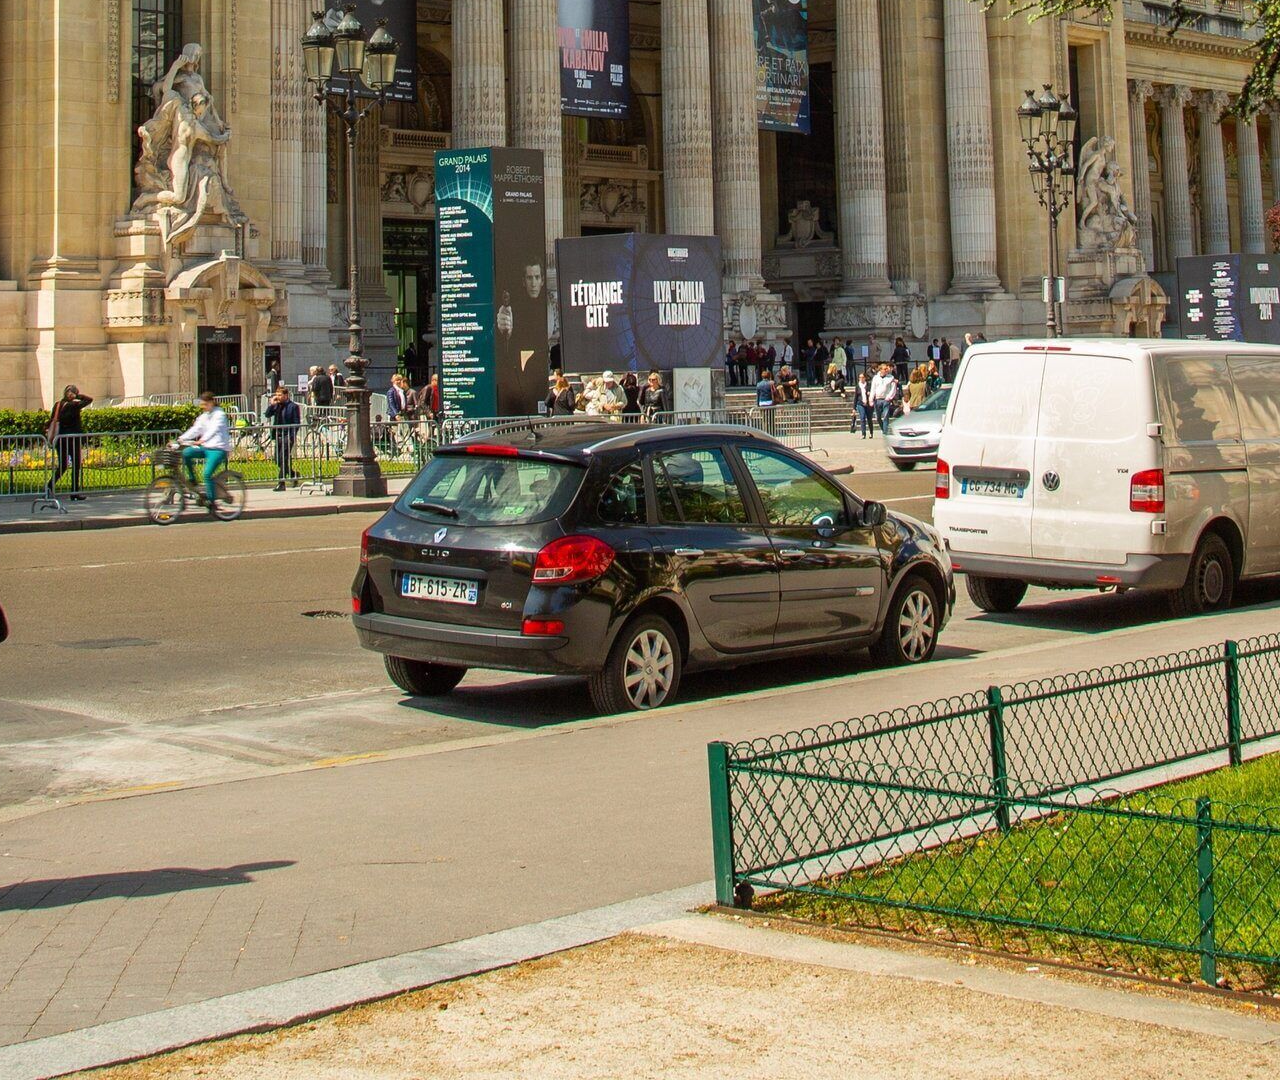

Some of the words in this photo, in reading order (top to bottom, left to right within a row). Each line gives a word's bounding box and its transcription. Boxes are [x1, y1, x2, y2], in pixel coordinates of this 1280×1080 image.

[563, 48, 604, 72] KABAKOV
[772, 57, 783, 71] ET
[785, 58, 807, 76] PAIX
[758, 70, 801, 87] ORTINARI
[439, 156, 464, 166] GRAND
[464, 154, 487, 164] PALAIS
[455, 164, 471, 174] 2014
[506, 165, 531, 174] ROBERT
[494, 174, 543, 184] MAPPLETHORPE
[571, 280, 623, 306] L'ÉTRANGE
[654, 281, 672, 303] ILYA
[676, 281, 705, 303] EMILIA
[659, 303, 701, 325] KABAKOV
[421, 548, 450, 557] CLIO
